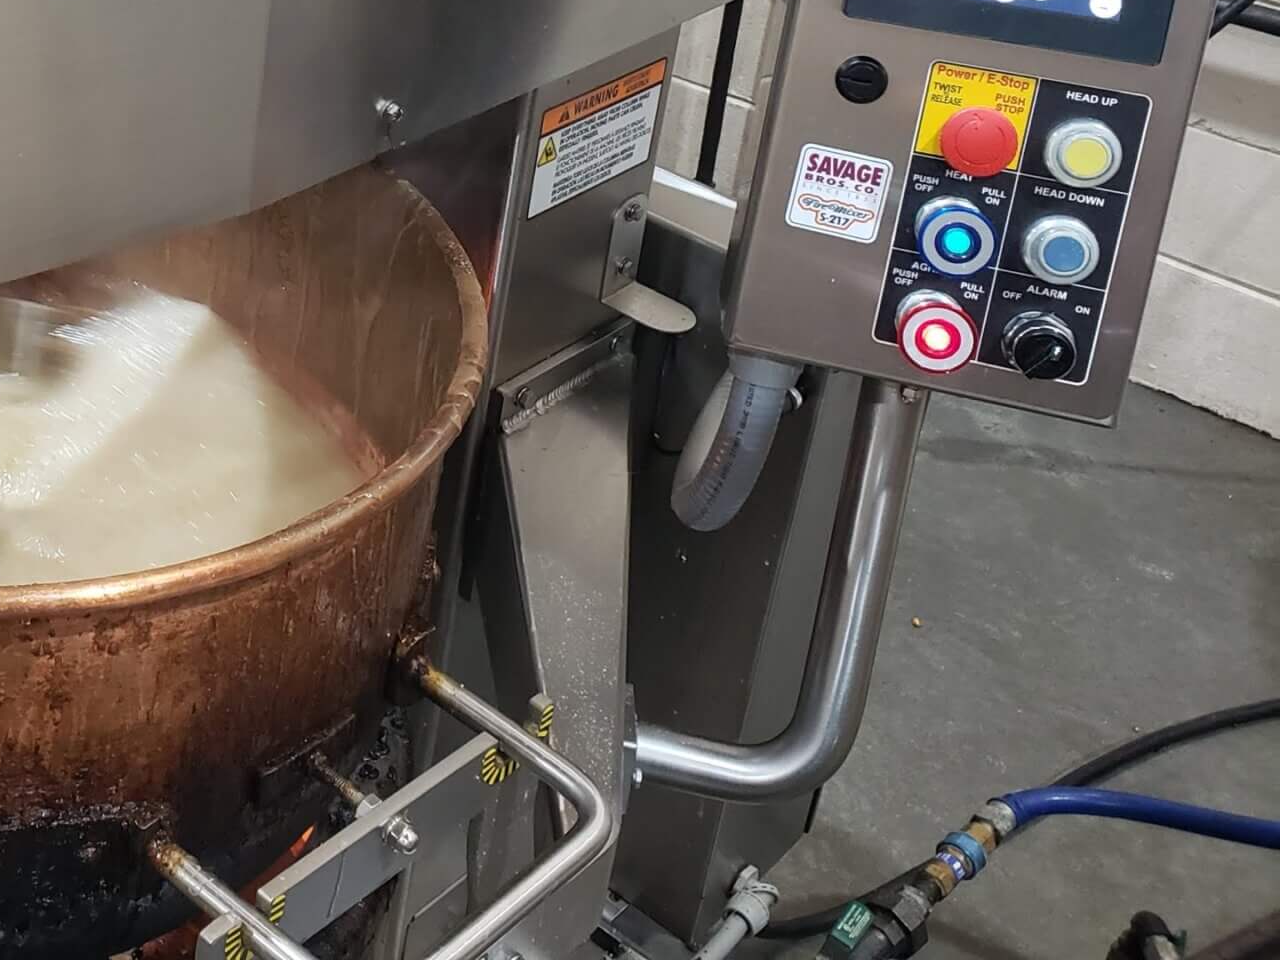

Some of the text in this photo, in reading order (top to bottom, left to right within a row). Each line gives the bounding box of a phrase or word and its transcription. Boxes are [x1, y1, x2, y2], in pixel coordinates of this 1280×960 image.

[937, 64, 977, 81] Power
[986, 73, 1030, 93] E-Stop
[934, 82, 963, 94] TWIST
[574, 84, 619, 114] WARNING
[995, 93, 1026, 106] PUSH
[1066, 91, 1118, 107] HEAD UP
[995, 103, 1024, 115] STOP
[807, 153, 884, 186] SAVAGE
[804, 173, 879, 196] BROS. CO.
[913, 174, 939, 185] PUSH
[914, 183, 935, 192] OFF
[981, 187, 1008, 199] PULL
[985, 197, 1001, 206] ON
[1034, 186, 1105, 207] HEAD DOWN
[820, 213, 850, 226] S-217
[892, 268, 919, 280] PUSH
[894, 276, 914, 287] OFF
[960, 281, 985, 293] PULL
[964, 291, 979, 300] ON
[1002, 290, 1023, 300] OFF
[1026, 285, 1068, 301] ALARM
[1075, 305, 1091, 315] ON
